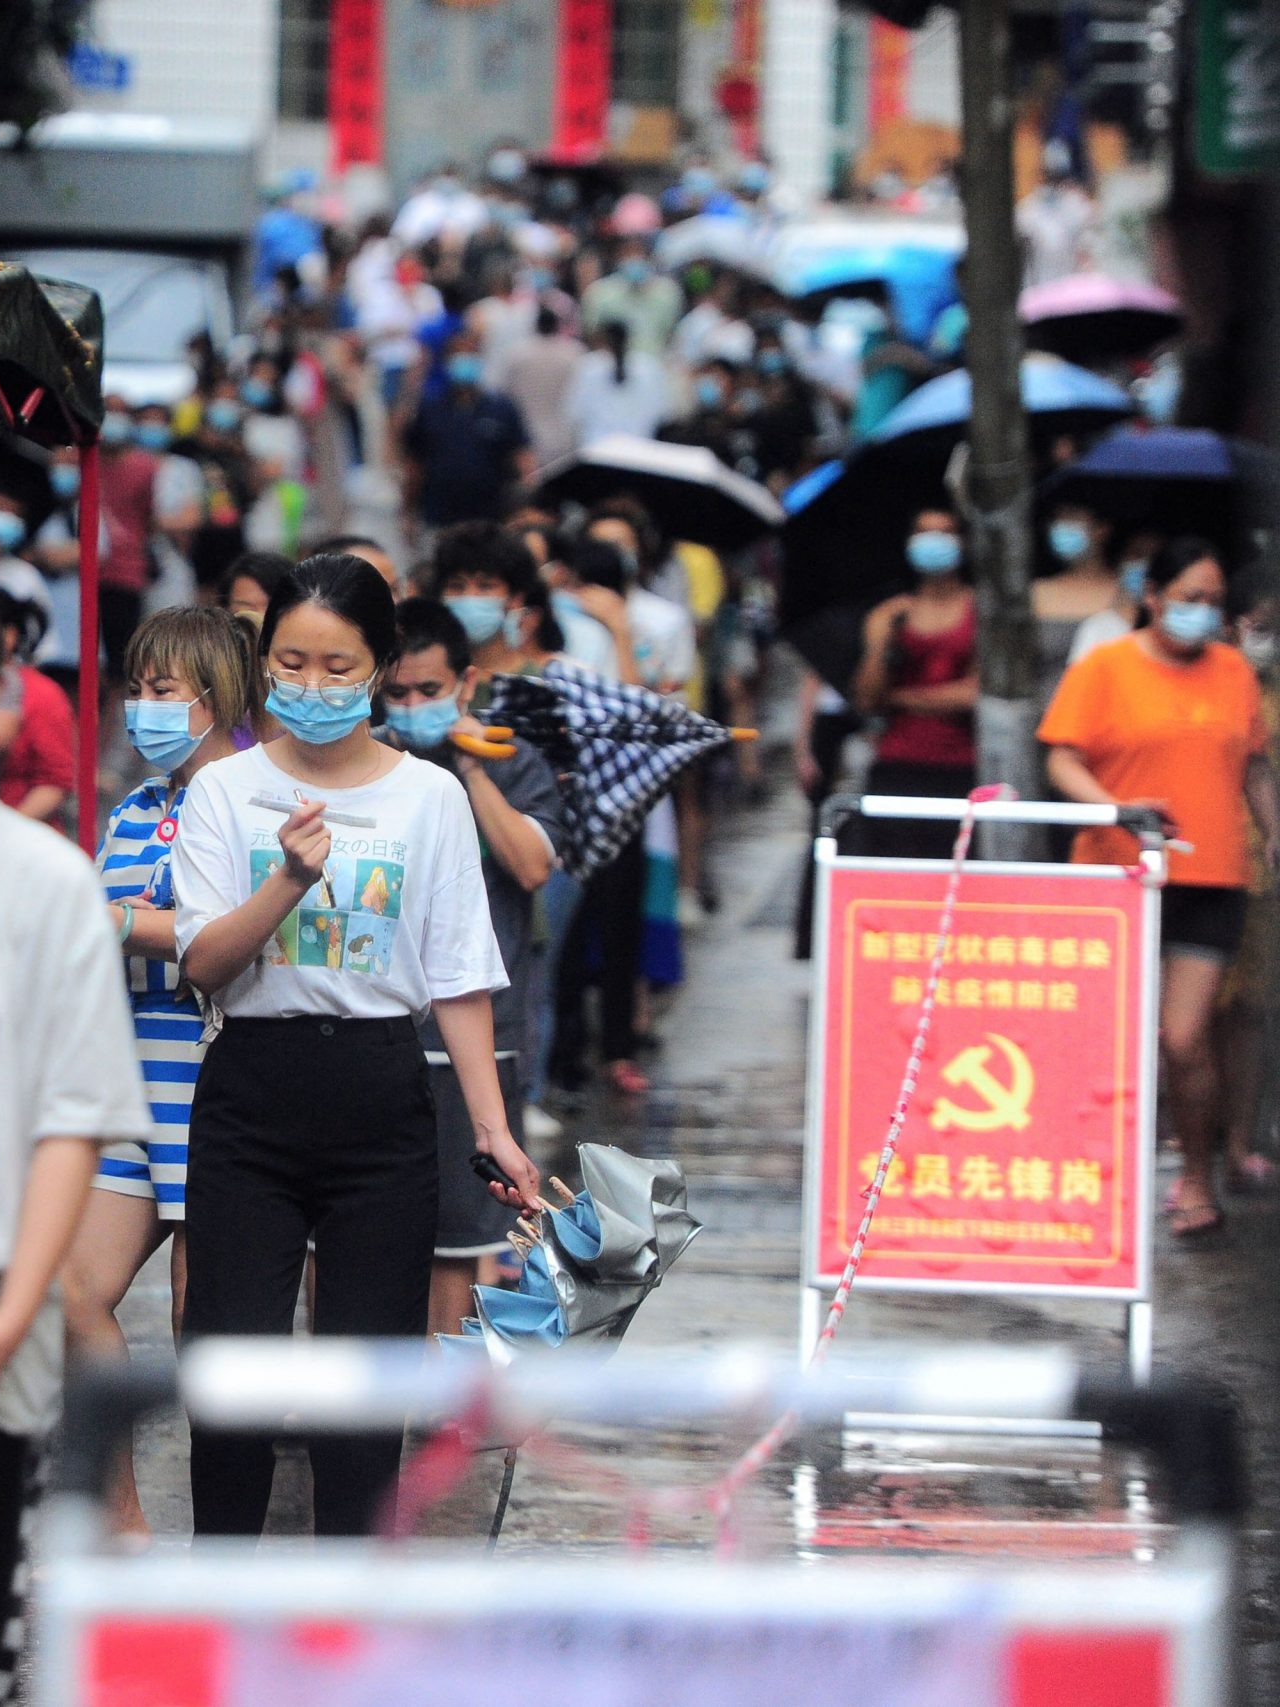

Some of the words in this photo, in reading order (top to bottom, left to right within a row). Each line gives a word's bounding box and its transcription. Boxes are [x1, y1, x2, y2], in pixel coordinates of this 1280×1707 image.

[251, 827, 407, 861] 元女の日常
[862, 930, 1111, 968] 新型冠状病毒感染
[858, 1152, 1102, 1205] 党员先锋岗
